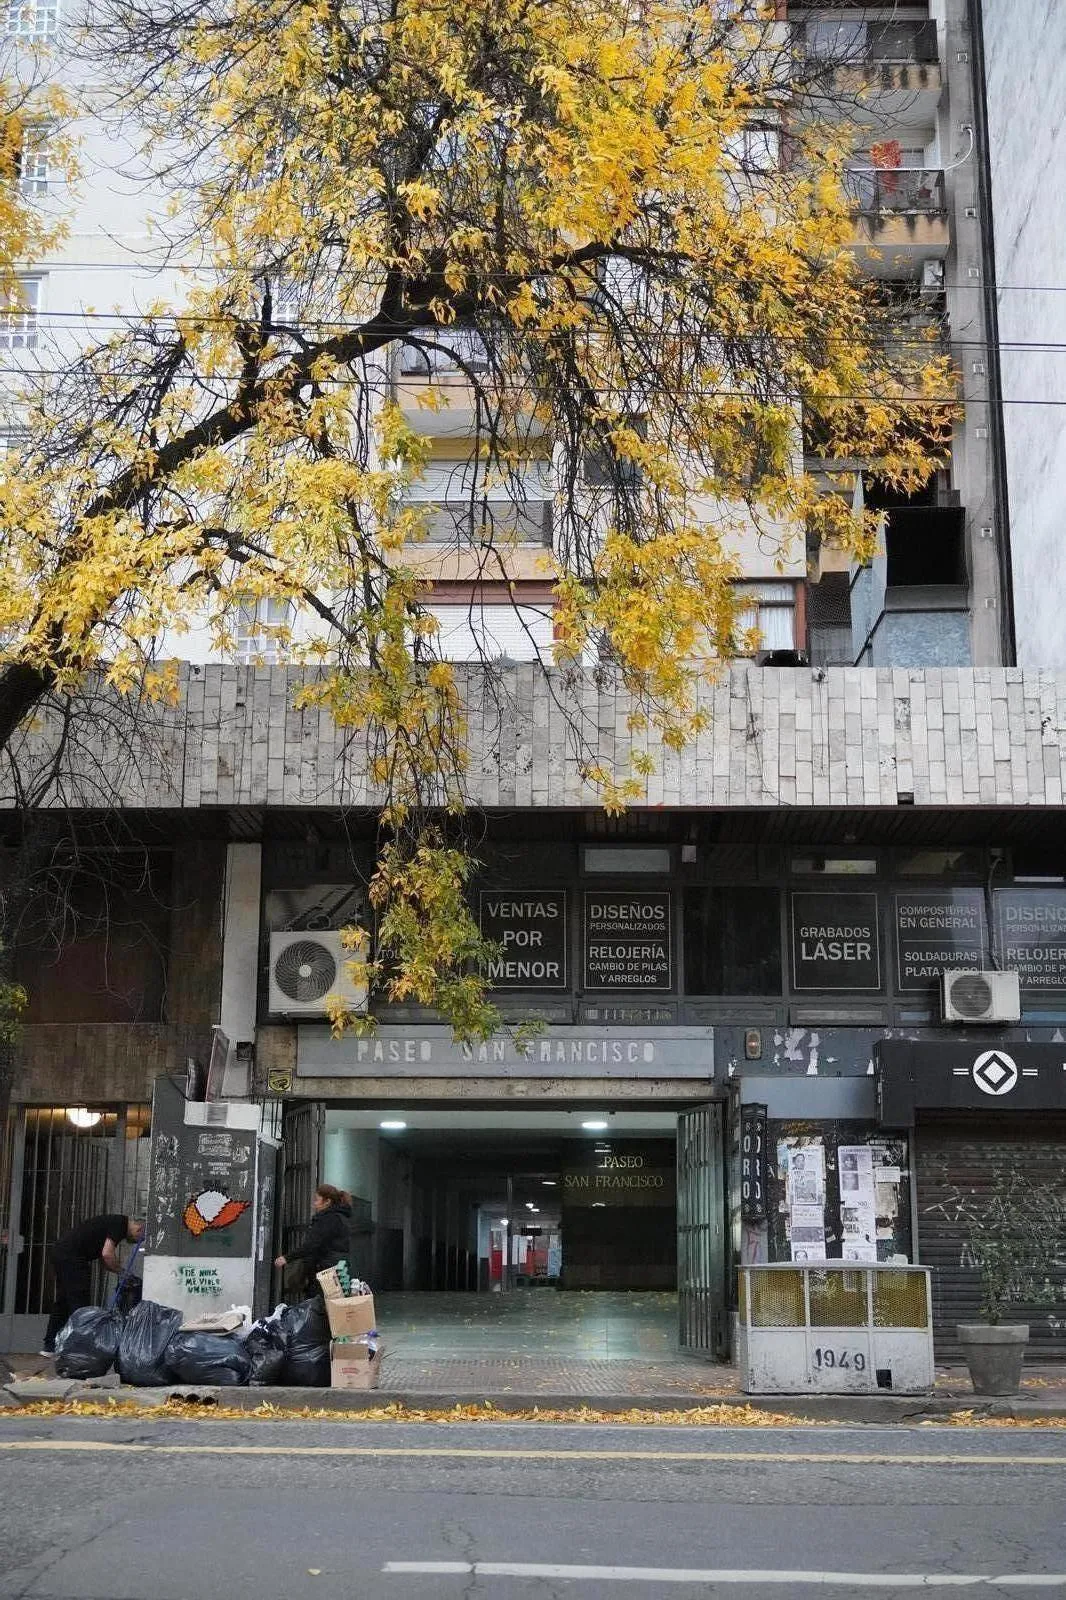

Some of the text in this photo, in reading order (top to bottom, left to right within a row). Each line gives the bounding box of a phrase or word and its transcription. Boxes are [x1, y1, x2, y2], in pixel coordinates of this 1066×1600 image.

[487, 902, 559, 918] VENTAS
[590, 901, 665, 919] DISEÑOS
[900, 906, 977, 916] COMPOSTURAS
[590, 922, 666, 931] PERSONALIZADOS
[900, 917, 976, 928] EN GENERAL
[503, 930, 543, 946] POR
[800, 927, 871, 938] GRABADOS
[590, 943, 665, 959] RELOJERÍA
[801, 939, 871, 961] LÁSER
[904, 951, 978, 961] SOLDADURAS
[488, 961, 559, 978] MENOR
[589, 962, 668, 971] CAMBIO DE PILAS
[905, 966, 940, 977] PLATA
[1007, 963, 1043, 972] CAMBIO
[1045, 963, 1057, 972] DE
[599, 974, 657, 983] Y ARREGLOS
[1018, 976, 1025, 984] Y
[356, 1040, 655, 1063] PASEO SAN FRANCISCO
[603, 1156, 643, 1168] PASEO
[743, 1135, 751, 1199] ORO
[565, 1176, 663, 1187] SAN FRANCISCO
[815, 1348, 866, 1371] 1949
